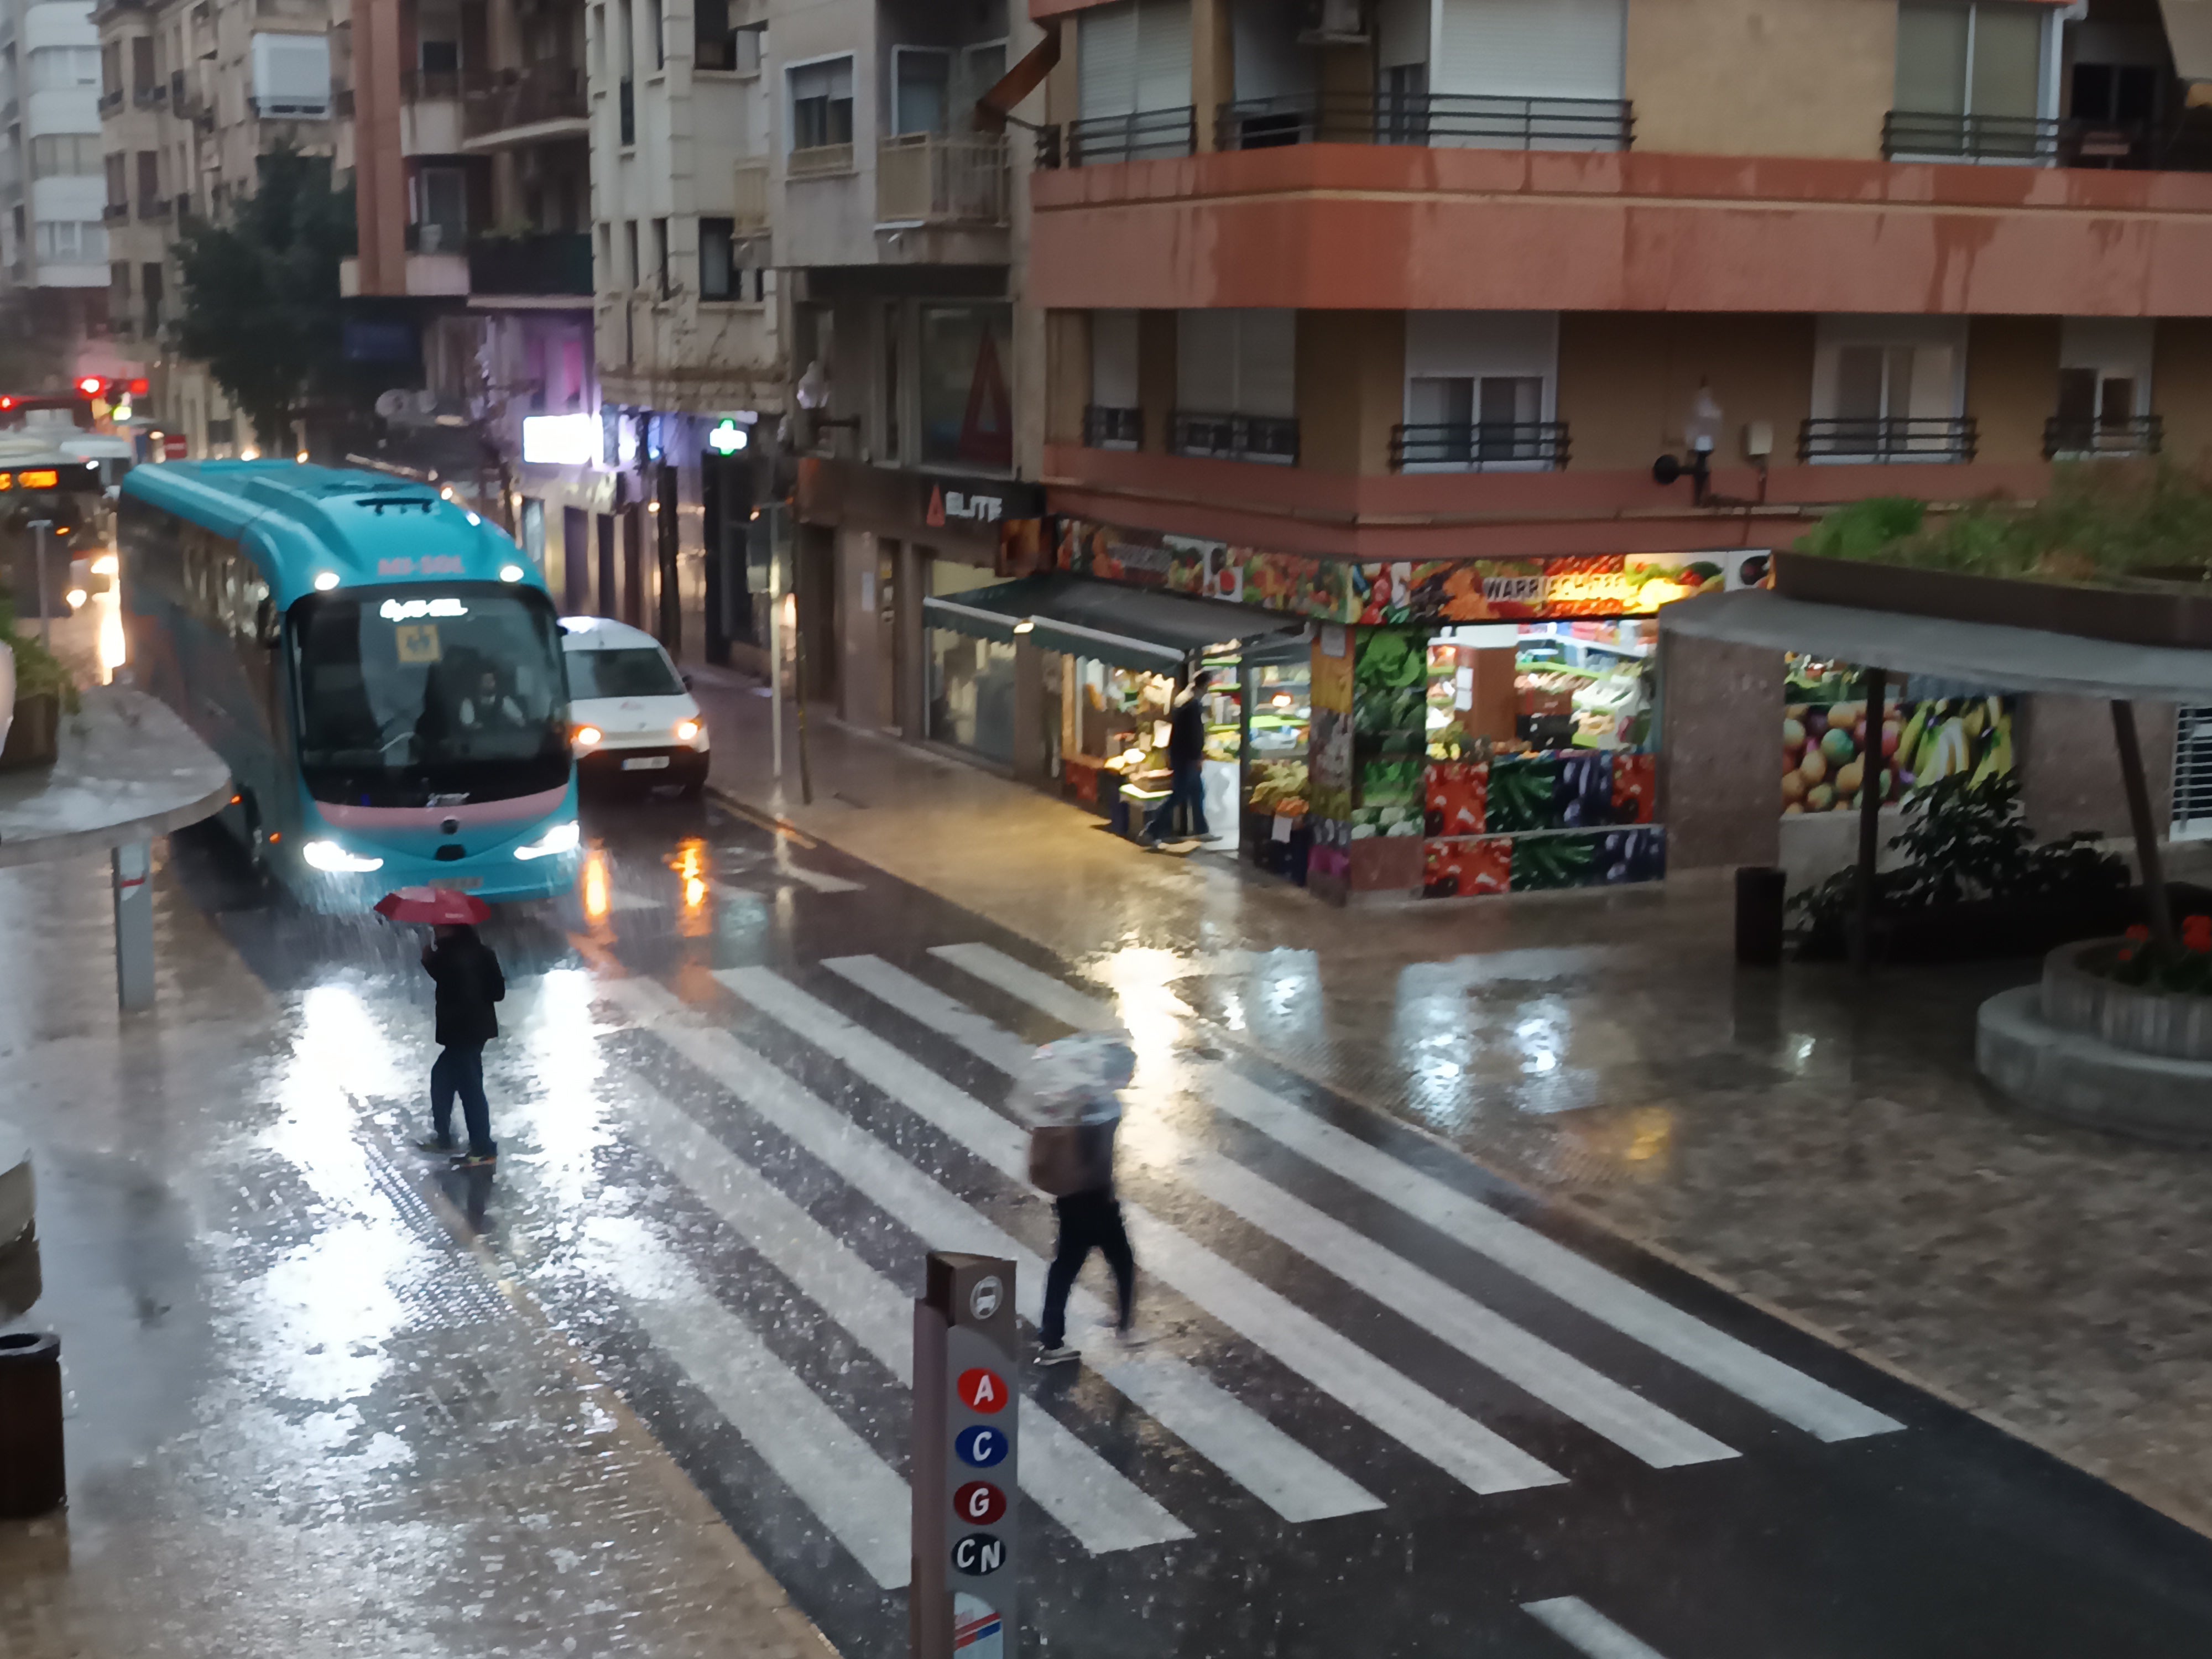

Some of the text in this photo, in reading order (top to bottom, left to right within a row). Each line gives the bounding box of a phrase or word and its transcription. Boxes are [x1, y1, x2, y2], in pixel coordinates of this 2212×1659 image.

[973, 1375, 994, 1406] A
[973, 1431, 992, 1462] C
[969, 1488, 990, 1517] G
[957, 1539, 1000, 1573] CN
